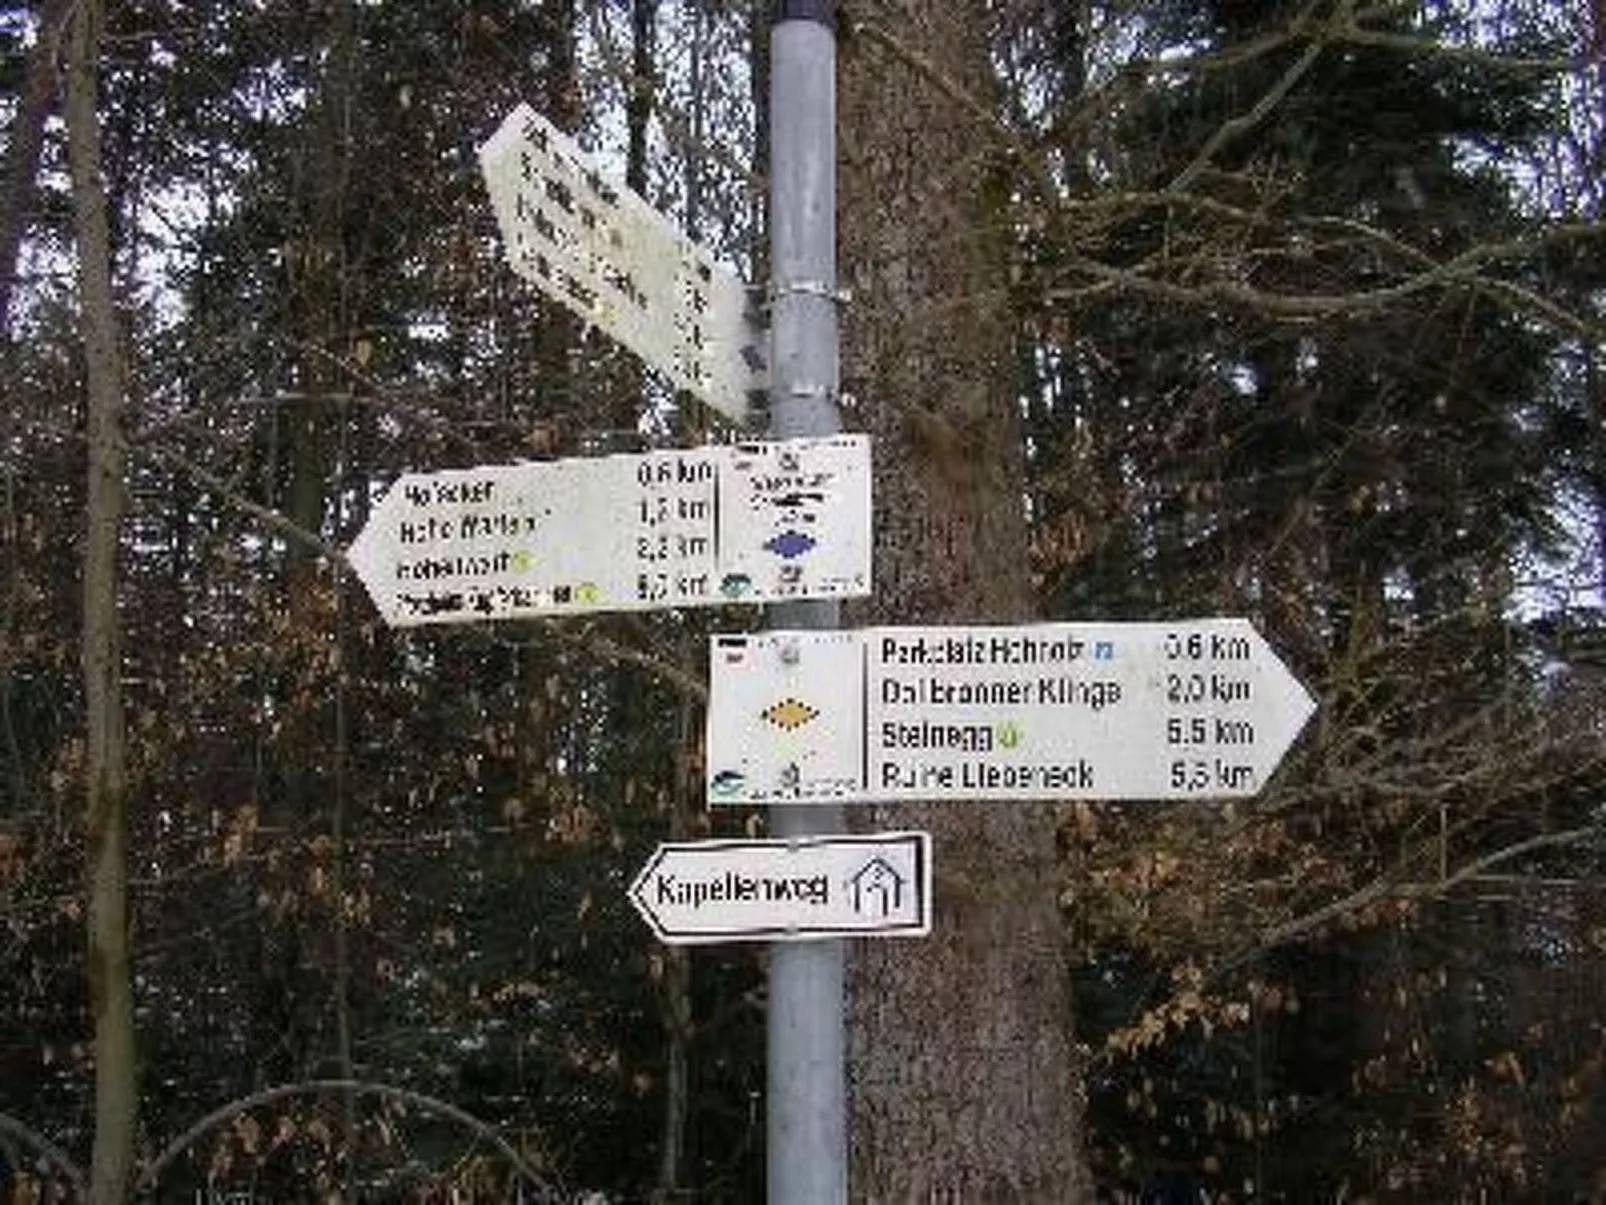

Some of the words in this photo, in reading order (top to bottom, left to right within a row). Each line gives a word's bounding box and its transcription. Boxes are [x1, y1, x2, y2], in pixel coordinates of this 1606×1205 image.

[678, 458, 712, 483] km
[678, 499, 709, 519] km
[678, 535, 708, 557] km
[1211, 634, 1250, 660] km
[1038, 678, 1122, 712] Klinge
[1167, 673, 1205, 704] 2,0
[1211, 673, 1250, 703] km
[882, 720, 993, 752] Steinegg
[1215, 718, 1254, 745] km
[882, 762, 952, 788] Ruine
[1215, 758, 1255, 789] km
